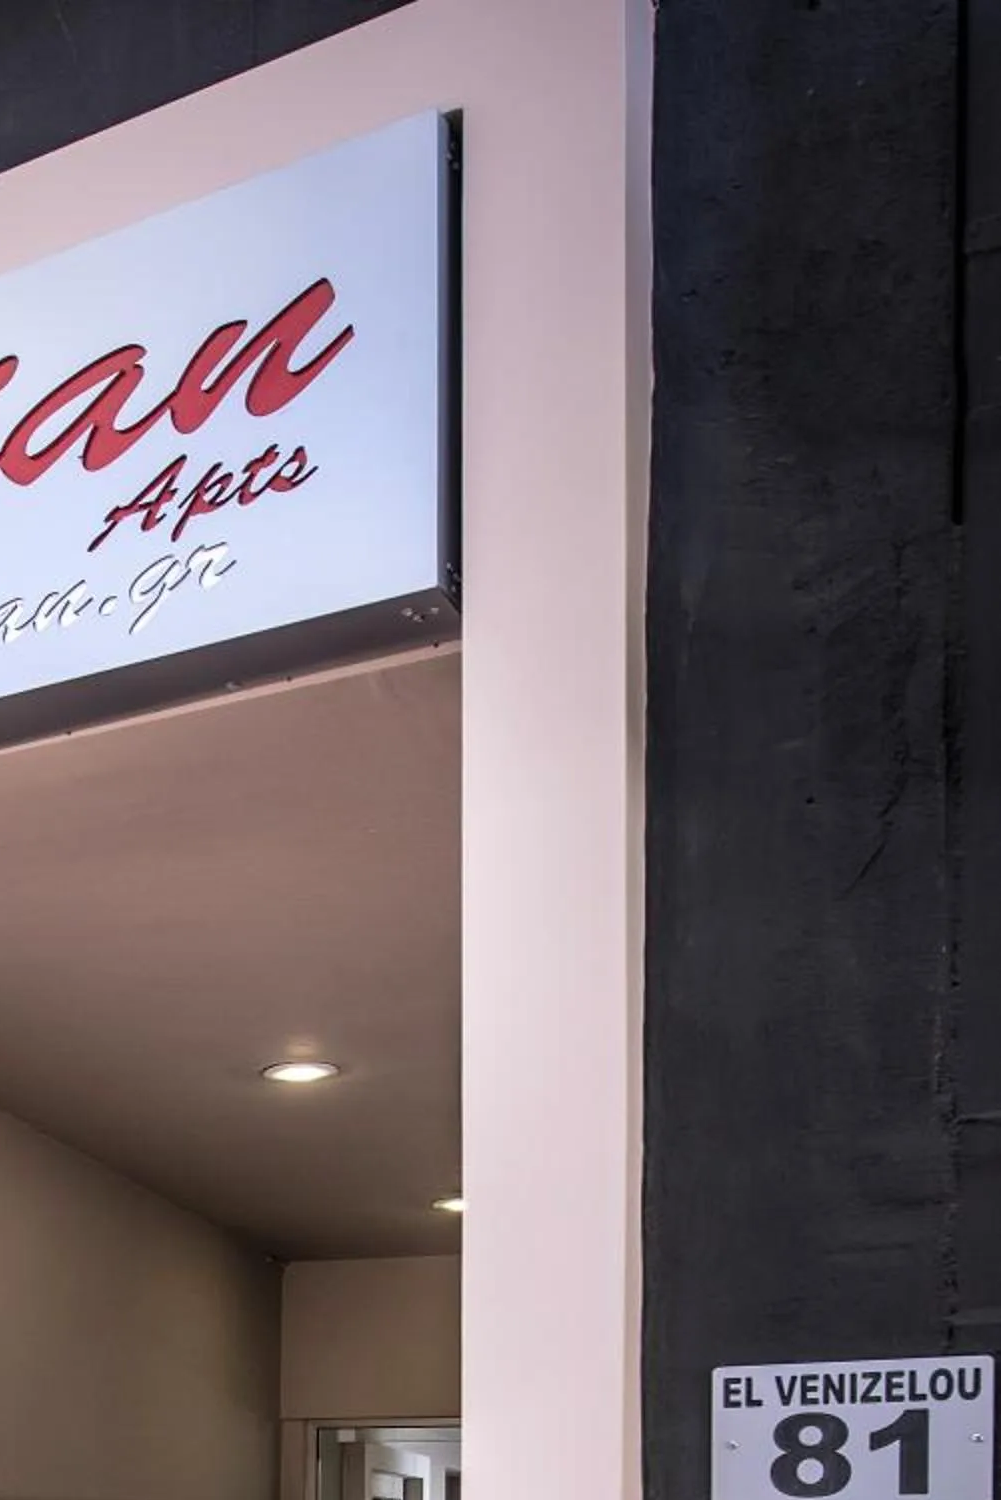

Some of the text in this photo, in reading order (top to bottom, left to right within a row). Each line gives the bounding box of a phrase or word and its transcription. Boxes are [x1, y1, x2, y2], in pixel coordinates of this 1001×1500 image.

[88, 443, 319, 553] Apts
[723, 1367, 982, 1408] EL VENIZELOU
[770, 1408, 929, 1498] 81
